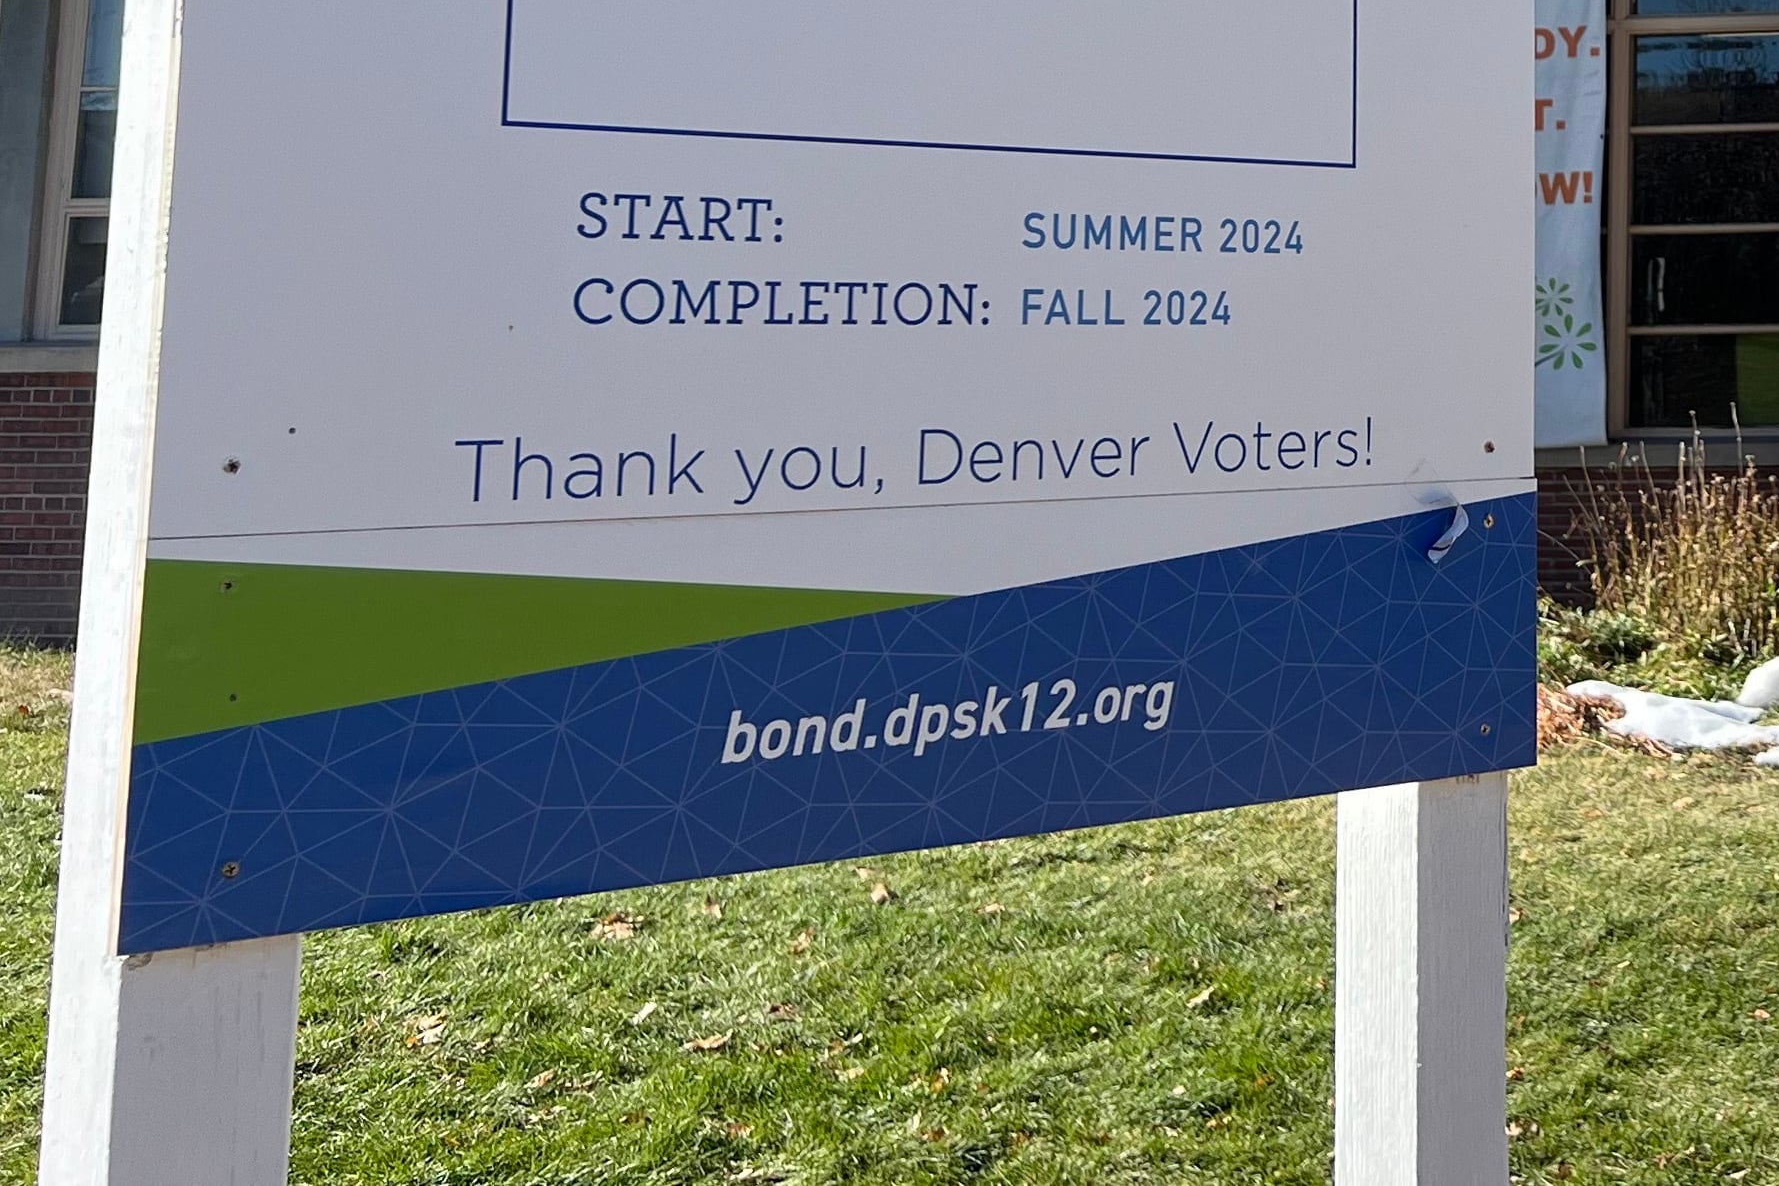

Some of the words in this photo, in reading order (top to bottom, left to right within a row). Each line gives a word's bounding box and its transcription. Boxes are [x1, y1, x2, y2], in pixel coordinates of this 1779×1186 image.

[1535, 25, 1600, 60] DY.
[577, 192, 785, 242] START:
[1022, 213, 1204, 253] SUMMER
[1219, 217, 1304, 256] 2024
[572, 277, 991, 327] COMPLETION:
[1021, 288, 1125, 326] FALL
[1142, 289, 1232, 327] 2024
[454, 433, 704, 502] Thank
[733, 440, 884, 505] you,
[918, 424, 1150, 488] Denver
[1173, 416, 1374, 476] Voters!
[722, 678, 1175, 764] bond.dpsk12.org
